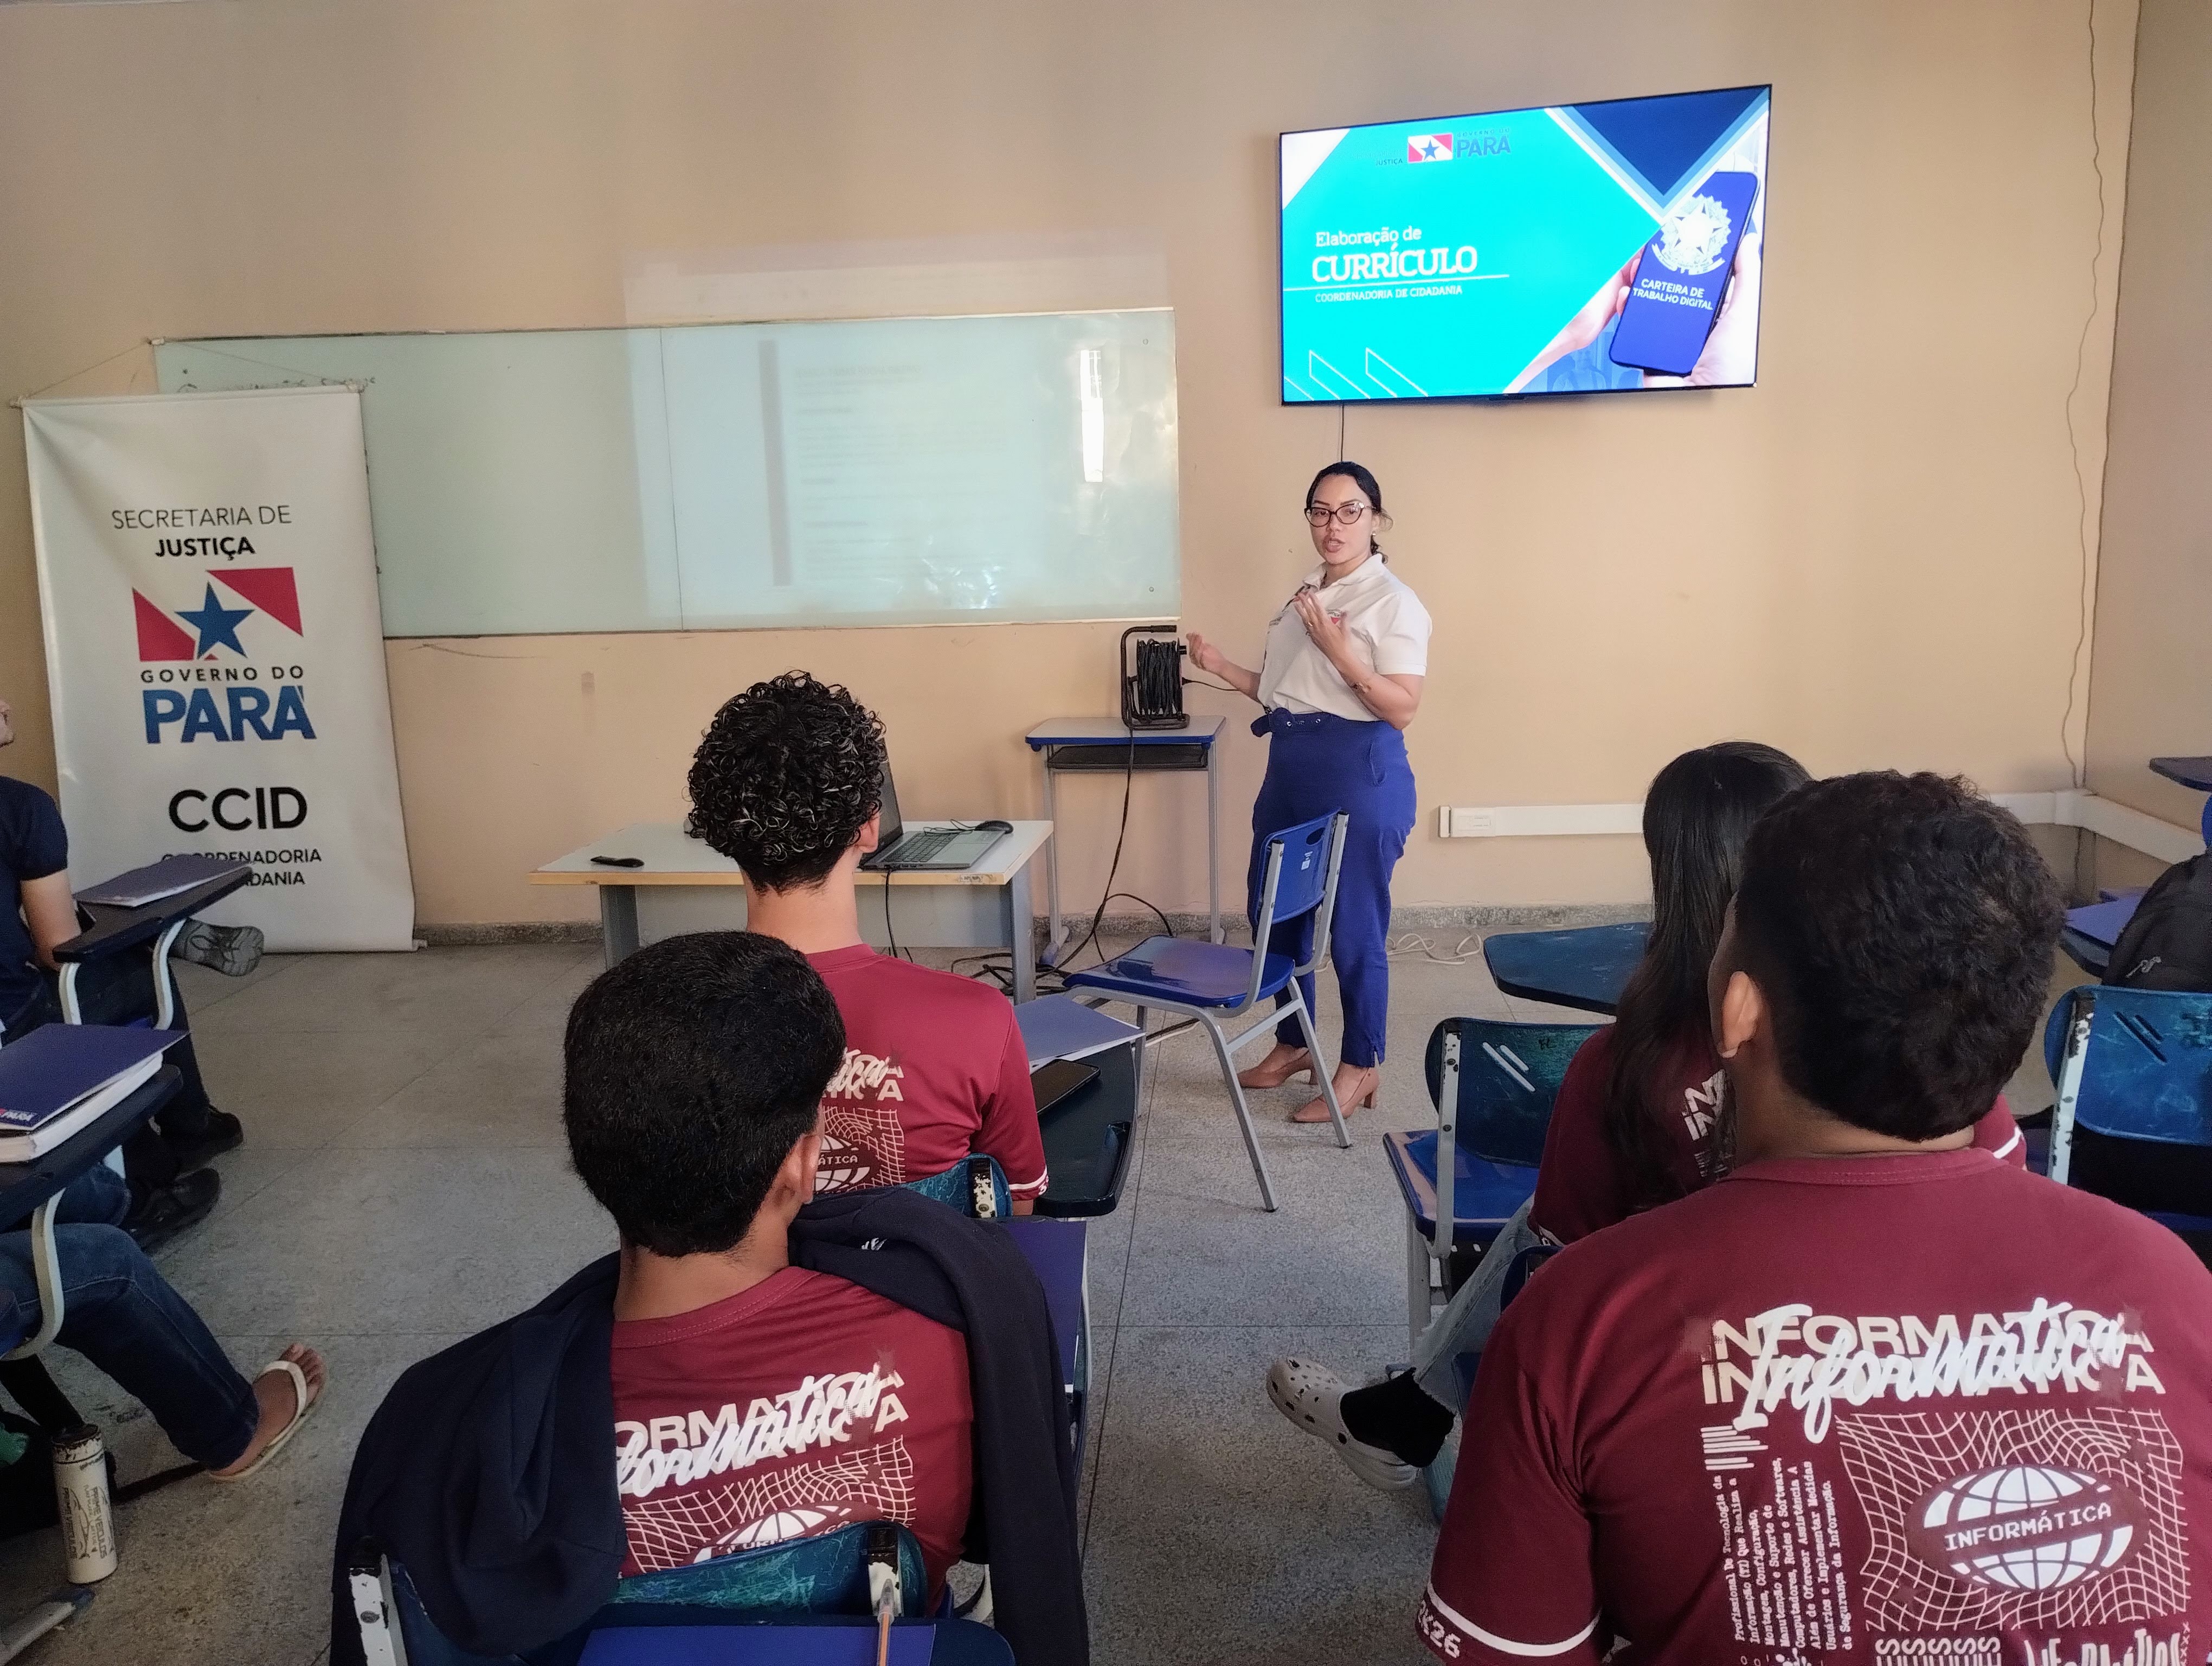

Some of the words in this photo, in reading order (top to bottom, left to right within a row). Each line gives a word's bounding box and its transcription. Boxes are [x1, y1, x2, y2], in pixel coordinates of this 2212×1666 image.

[1375, 158, 1403, 166] JUSTIÇA
[1315, 227, 1399, 247] Elaboração
[1402, 225, 1423, 241] de
[1312, 242, 1478, 283] CURRÍCULO
[1315, 287, 1393, 303] COORDENADORIA
[1395, 287, 1409, 298] DE
[1410, 285, 1463, 298] CIDADANIA
[1633, 287, 1679, 304] TRABALHO
[1680, 296, 1714, 310] DIGITAL
[1641, 278, 1688, 296] CARTEIRA
[1690, 286, 1706, 298] DE
[112, 507, 253, 529] SECRETARIA
[258, 505, 292, 524] DE
[155, 536, 255, 561] JUSTIÇA
[140, 667, 258, 684] GOVERNO
[272, 665, 304, 680] DO
[168, 787, 308, 833] CCID
[1713, 1475, 1722, 1489] da
[1728, 1477, 1737, 1486] a
[1787, 1466, 1798, 1475] A
[1803, 1461, 1818, 1507] Medidas
[1715, 1494, 1731, 1553] Tecnologia
[1731, 1490, 1744, 1534] Realiza
[1762, 1504, 1773, 1518] de
[1790, 1479, 1808, 1545] Assistência
[1944, 1502, 2112, 1552] INFORMÁTICA
[1737, 1537, 1749, 1556] Que
[1765, 1522, 1780, 1567] Suporte
[1782, 1532, 1795, 1565] Redes
[1811, 1511, 1829, 1584] Implementar
[1724, 1558, 1734, 1570] De
[1831, 1552, 1842, 1567] da
[1801, 1549, 1814, 1599] Oferecer
[1726, 1573, 1745, 1641] Profissional
[1743, 1581, 1760, 1644] Informação
[1773, 1582, 1790, 1647] Manutenção
[1806, 1603, 1817, 1617] de
[1835, 1572, 1851, 1632] Segurança
[1809, 1621, 1821, 1649] Além
[1822, 1599, 1836, 1650] Usuários
[1842, 1636, 1853, 1650] de
